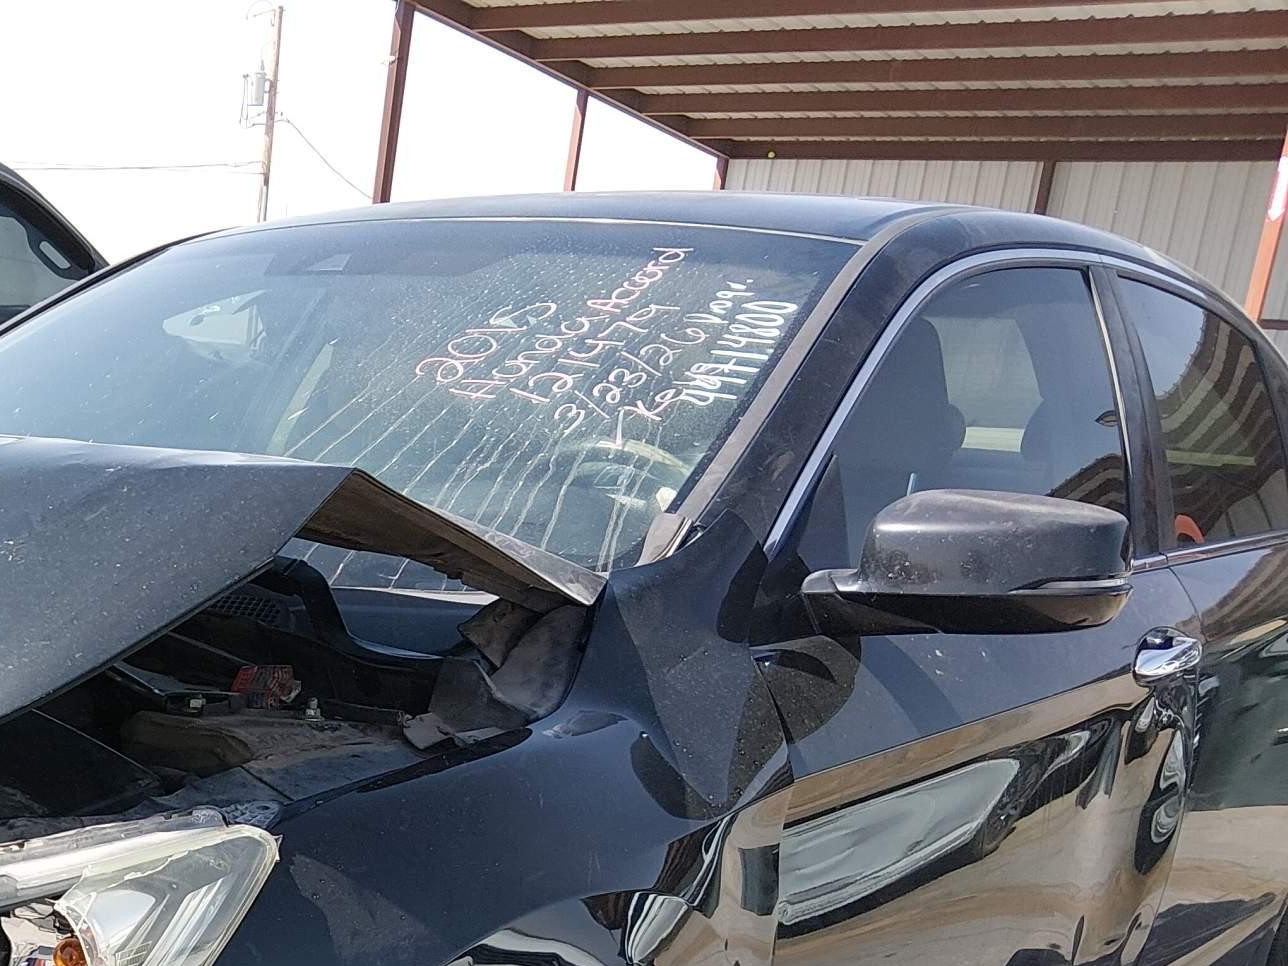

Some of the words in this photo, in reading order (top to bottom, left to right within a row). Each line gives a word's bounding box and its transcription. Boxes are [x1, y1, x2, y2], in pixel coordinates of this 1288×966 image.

[415, 301, 558, 385] 2015
[448, 314, 609, 399] Honda
[586, 247, 695, 313] Accord
[509, 304, 681, 403] 121479
[553, 326, 711, 440] 3/23/26
